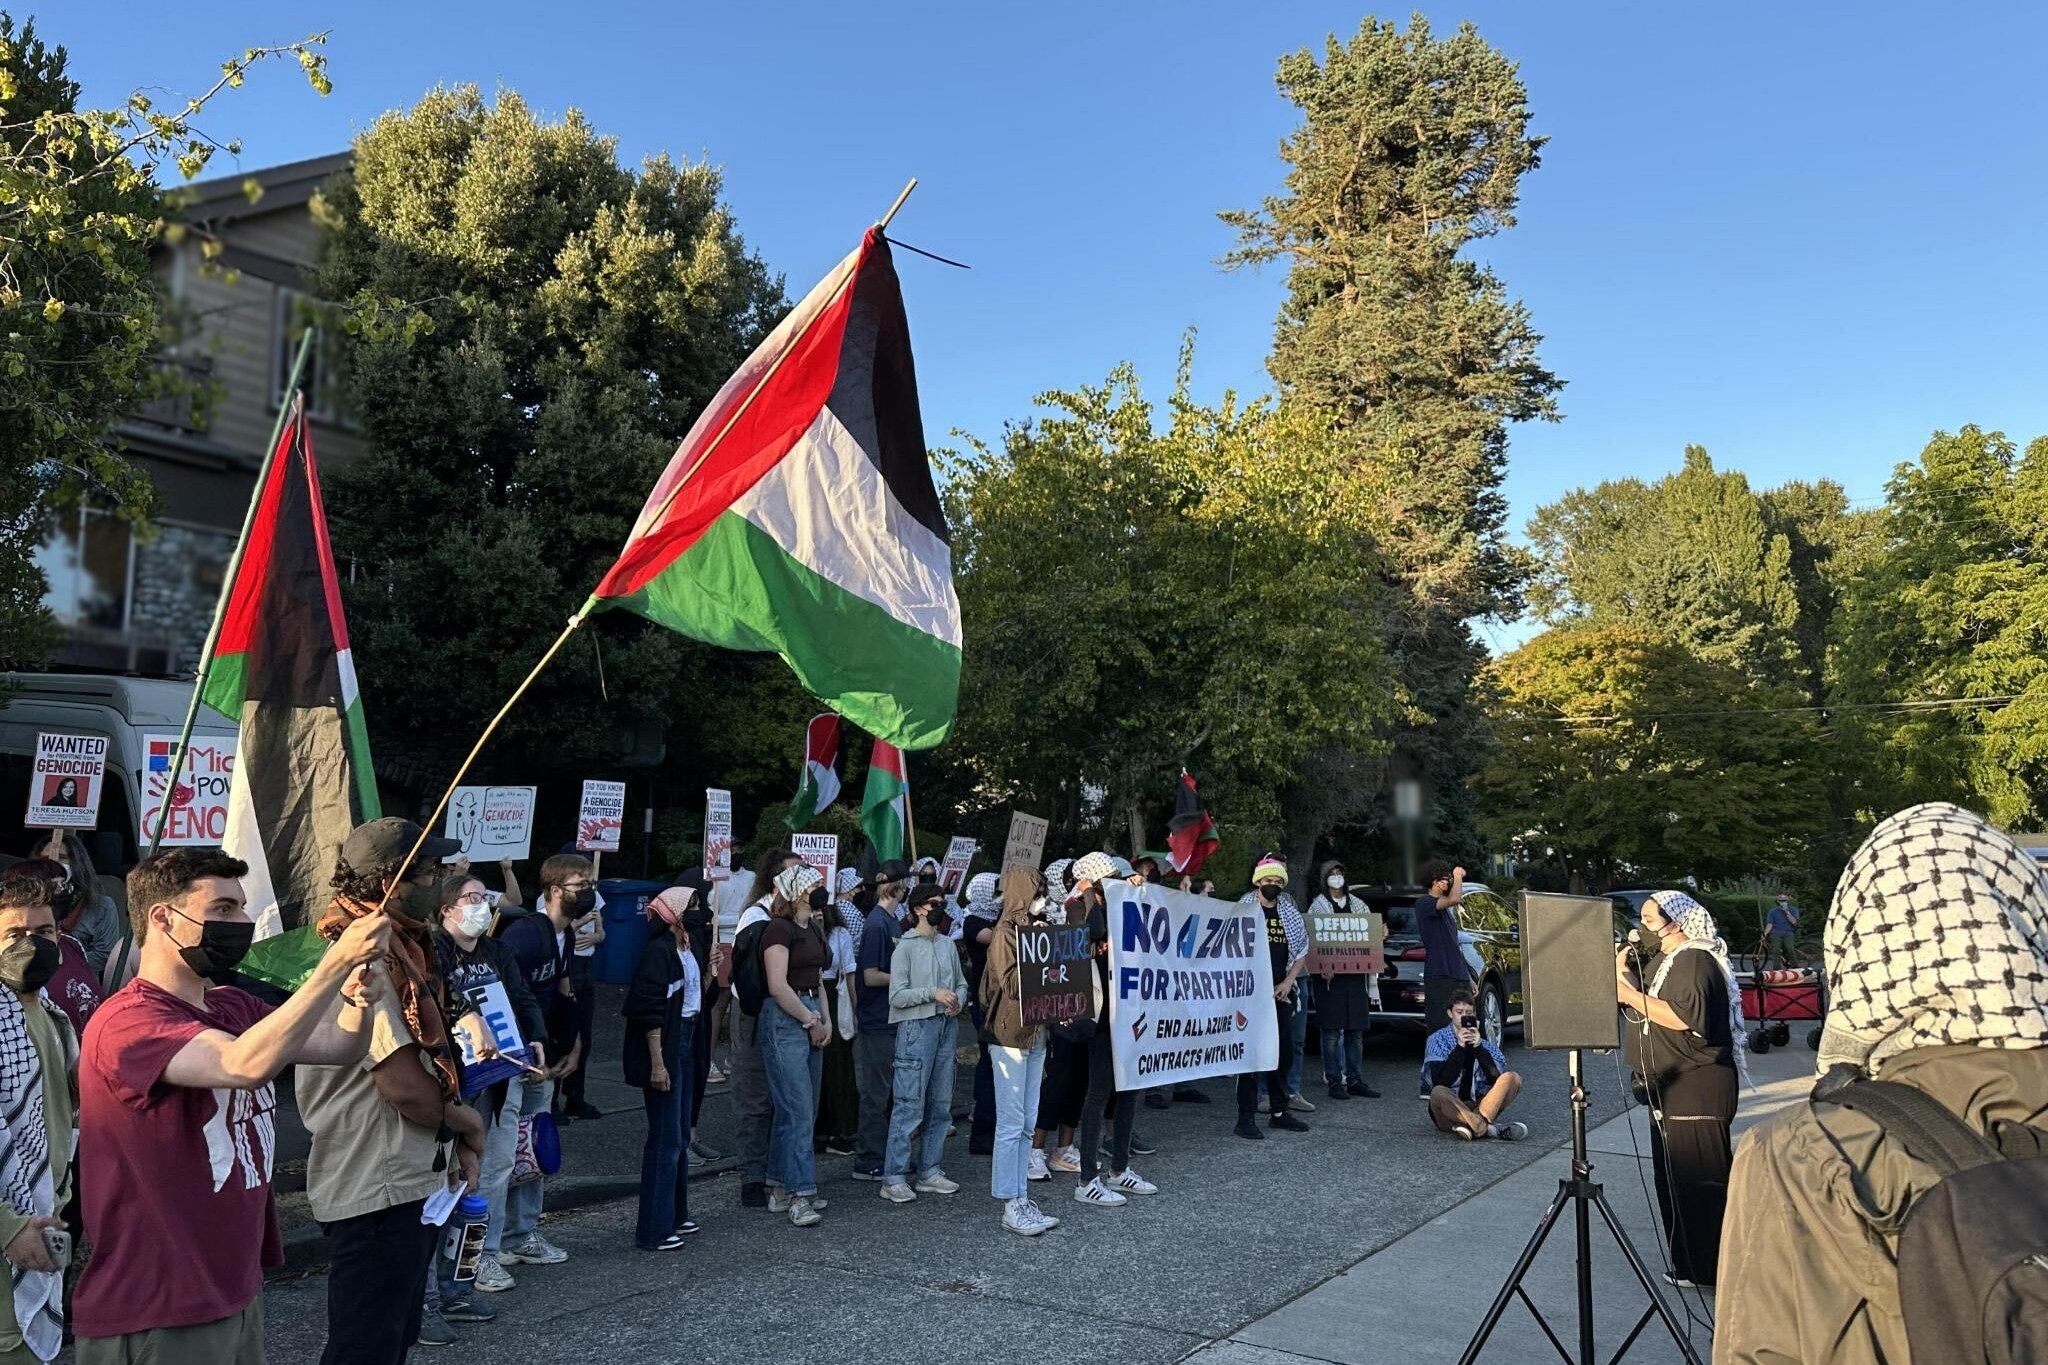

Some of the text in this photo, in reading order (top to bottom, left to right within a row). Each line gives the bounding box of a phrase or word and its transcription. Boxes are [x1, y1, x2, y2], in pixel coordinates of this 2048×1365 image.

[42, 735, 104, 754] WANTED
[37, 759, 102, 775] GENOCIDE
[584, 797, 622, 807] A GENOCIDE
[485, 809, 525, 821] GENOCIDE
[583, 806, 621, 817] PROFITEER?
[794, 835, 836, 849] WANTED
[1122, 901, 1256, 959] NO AZURE
[1314, 917, 1369, 931] DEFUND
[1021, 927, 1091, 963] NO AZURE
[1315, 932, 1370, 942] GENOCIDE
[1317, 947, 1370, 956] FREE PALESTINE
[1041, 964, 1069, 986] FOR
[1120, 967, 1255, 1001] FOR APARTHEID
[1023, 992, 1088, 1023] APARTHEID
[1156, 1015, 1233, 1038] END ALL AZURE
[1138, 1043, 1244, 1076] CONTRACTS WITH IOF
